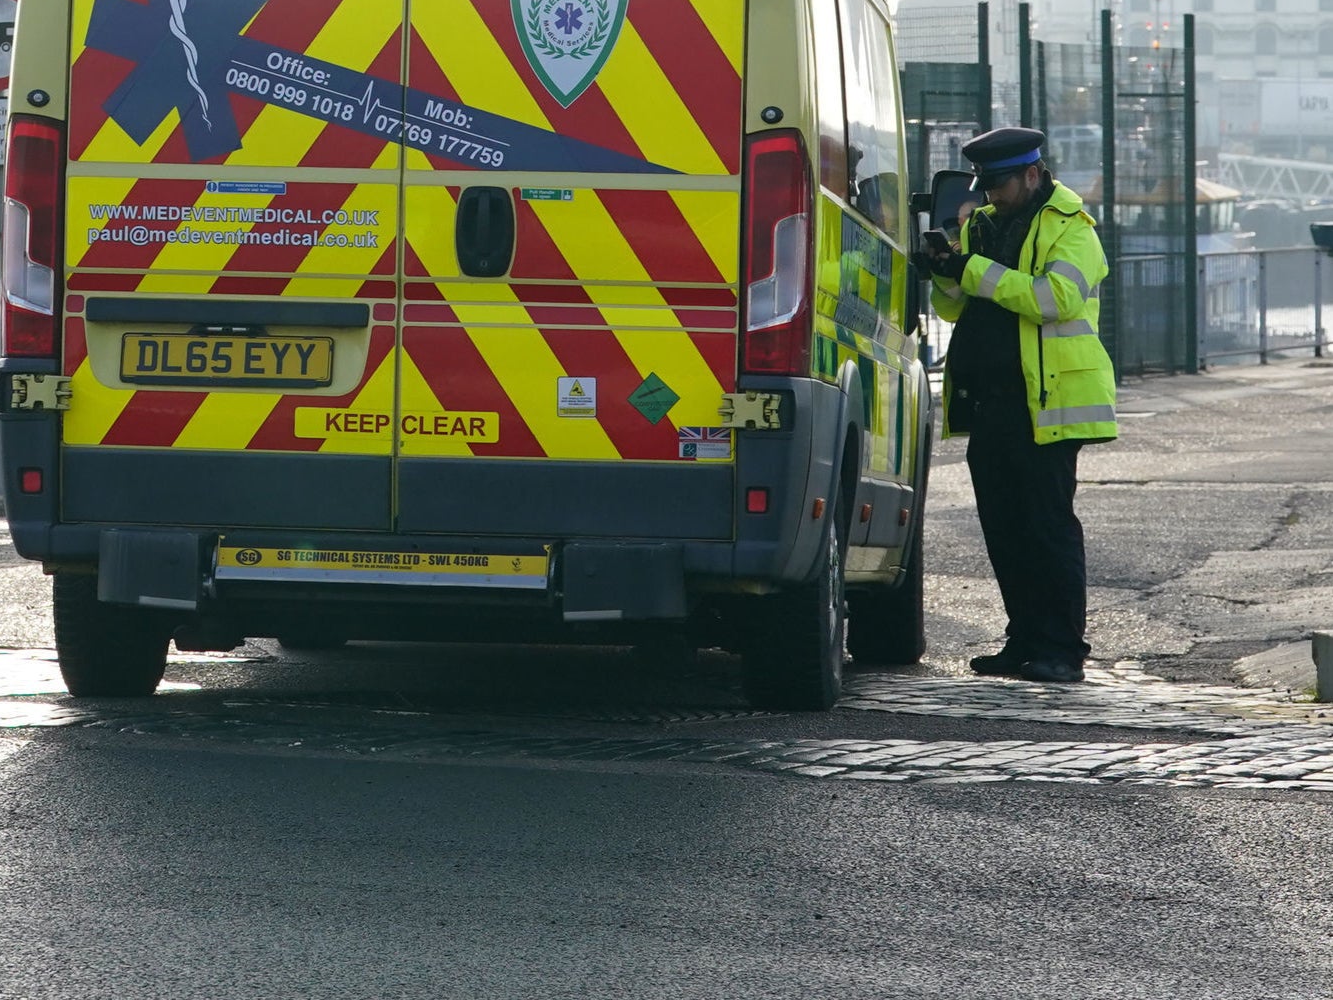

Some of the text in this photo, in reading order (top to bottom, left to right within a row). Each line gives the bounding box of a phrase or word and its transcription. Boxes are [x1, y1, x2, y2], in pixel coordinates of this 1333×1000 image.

[543, 20, 594, 46] Medical Services
[266, 52, 331, 86] Office:
[226, 68, 355, 121] 0800 999 1018
[424, 100, 474, 129] Mob:
[374, 114, 505, 168] 07769 177759
[89, 205, 379, 226] WWW.MEDEVENTMEDICAL.CO.UK
[88, 226, 378, 247] paul@medeventmedical.co.uk
[136, 340, 316, 375] DL65 EYY
[325, 413, 486, 437] KEEP CLEAR
[241, 551, 257, 562] SG
[277, 550, 292, 562] SG
[294, 551, 350, 564] TECHNICAL
[352, 553, 401, 565] SYSTEMS
[403, 554, 420, 566] LTD
[428, 555, 451, 566] SWL
[453, 555, 489, 567] 450KG
